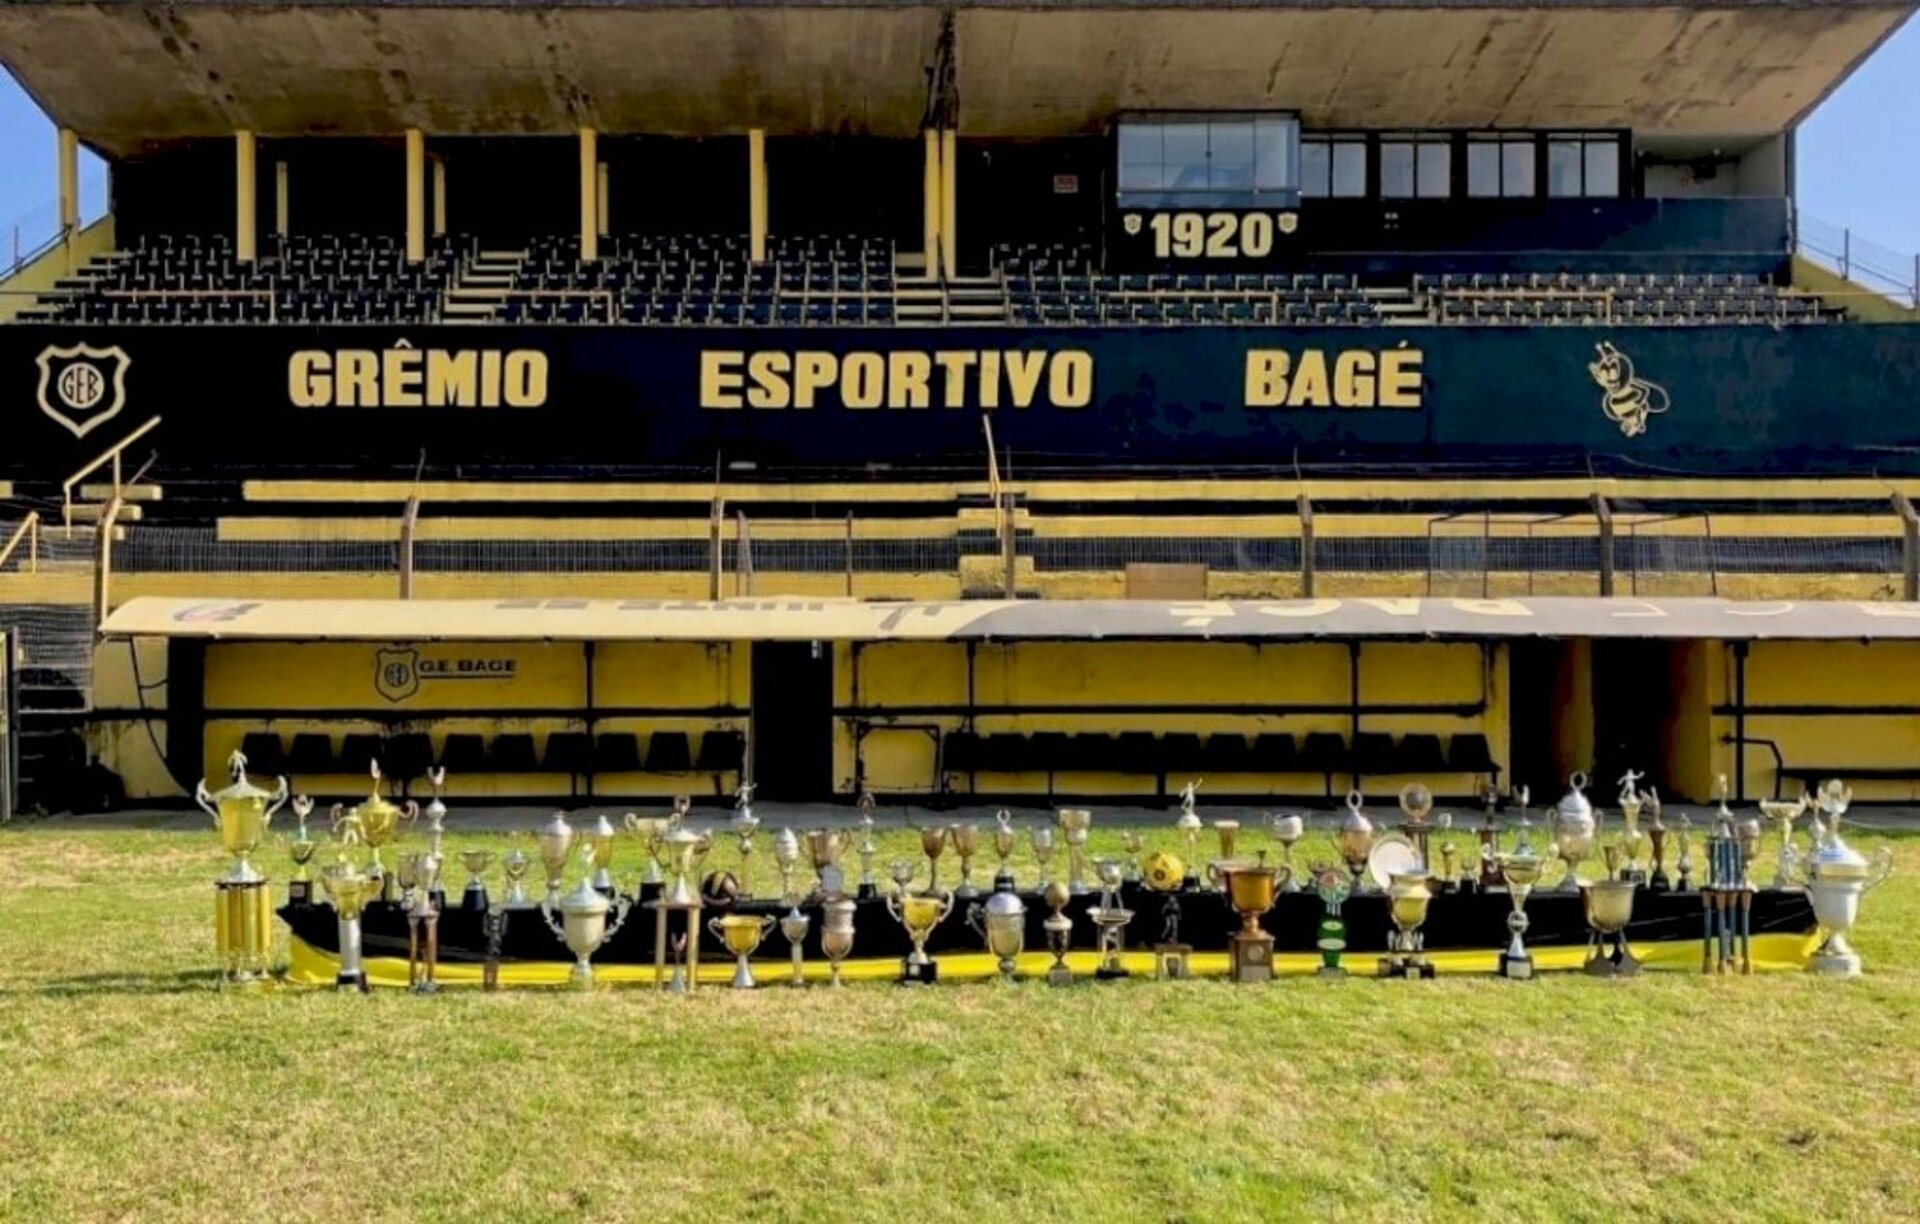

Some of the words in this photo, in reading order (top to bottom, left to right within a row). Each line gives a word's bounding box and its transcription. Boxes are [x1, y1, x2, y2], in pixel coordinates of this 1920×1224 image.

[1150, 212, 1273, 258] 1920
[288, 337, 548, 407] GRÊMIO
[700, 350, 1094, 409] ESPORTIVO
[1244, 340, 1423, 407] BAGÉ
